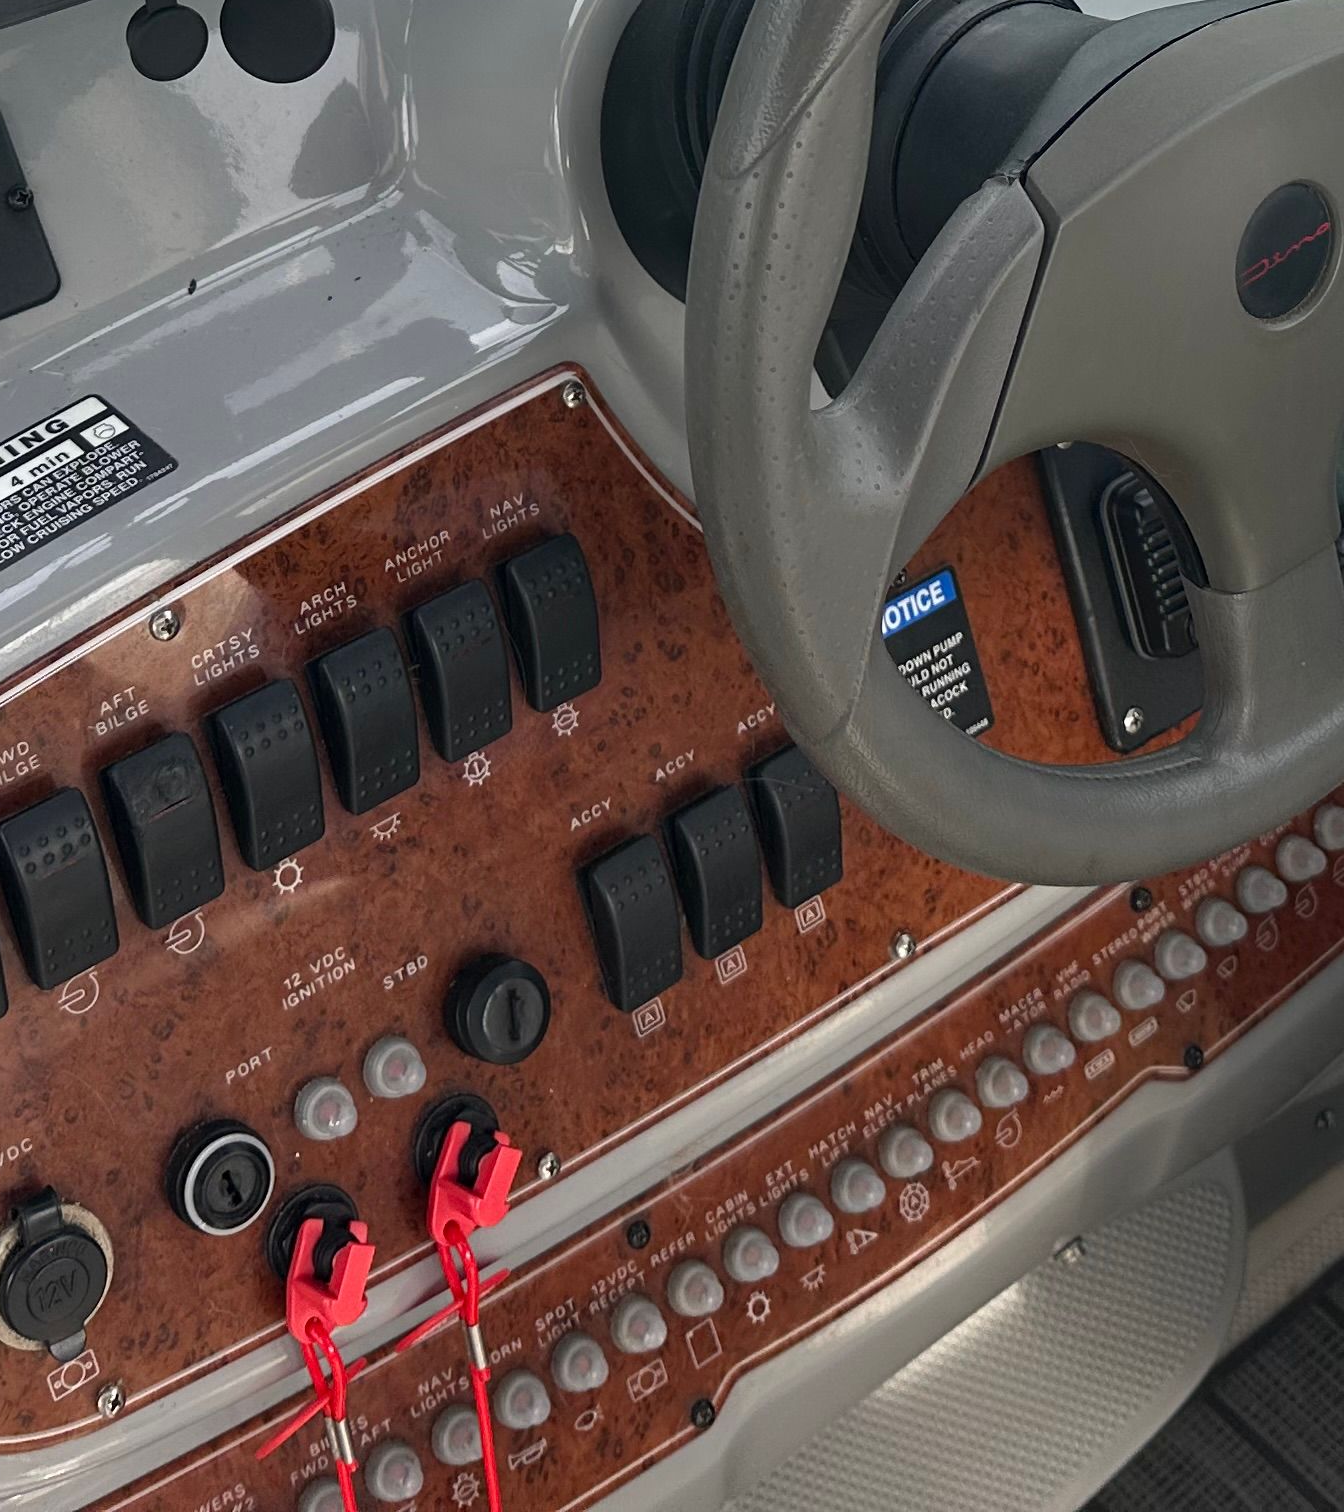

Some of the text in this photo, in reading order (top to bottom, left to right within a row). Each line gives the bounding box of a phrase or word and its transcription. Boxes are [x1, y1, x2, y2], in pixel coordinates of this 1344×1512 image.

[11, 452, 70, 487] 4 min
[19, 473, 82, 511] OPERATE
[82, 440, 141, 476] BLOWER
[22, 476, 53, 497] CAN
[53, 441, 119, 480] EXPLODE.
[20, 513, 58, 536] FUEL
[56, 480, 116, 514] VAPORS.
[116, 461, 147, 480] RUN
[23, 488, 76, 521] ENGINE
[28, 504, 93, 544] CRUISING
[93, 478, 143, 506] SPEED.
[490, 493, 524, 519] NAV
[482, 503, 541, 539] LIGHTS
[384, 530, 452, 572] ANCHOR
[396, 551, 444, 583] LIGHT
[294, 596, 357, 635] LIGHTS
[299, 581, 347, 615] ARCH
[190, 627, 254, 669] CRTSY
[193, 644, 260, 687] LIGHTS
[898, 632, 963, 675] DOWN PUMP
[931, 654, 954, 676] NOT
[921, 662, 971, 696] RUNNING
[95, 698, 150, 737] BILGE
[99, 686, 137, 717] AFT
[737, 702, 776, 734] ACCY
[656, 749, 695, 781] ACCY
[570, 797, 611, 830] ACCY
[1092, 928, 1138, 965] STEREO
[282, 958, 356, 1010] IGNITION
[284, 947, 346, 990] 12 VDC
[383, 955, 428, 990] STBD
[1054, 970, 1091, 1000] RADIO
[999, 988, 1043, 1024] MACER
[960, 1030, 994, 1061] HEAD
[225, 1046, 273, 1085] PORT
[912, 1058, 944, 1084] TRIM
[907, 1065, 957, 1106] PLANES
[863, 1103, 903, 1138] ELECT
[864, 1093, 893, 1121] NAV
[808, 1121, 856, 1159] HATCH
[821, 1141, 850, 1167] LIFT
[759, 1168, 809, 1207] LIGHTS
[766, 1160, 793, 1186] EXT
[705, 1202, 756, 1241] LIGHTS
[706, 1190, 748, 1224] CABIN
[650, 1231, 696, 1267] REFER
[38, 1270, 76, 1312] 12V
[589, 1271, 646, 1315] RECEPT
[592, 1260, 637, 1295] 12VDC
[535, 1298, 575, 1331] SPOT
[537, 1312, 581, 1348] LIGHT
[488, 1337, 522, 1365] ORN
[411, 1376, 469, 1418] LIGHTS
[418, 1367, 453, 1396] NAV
[291, 1457, 328, 1486] FWD
[361, 1419, 391, 1447] AFT
